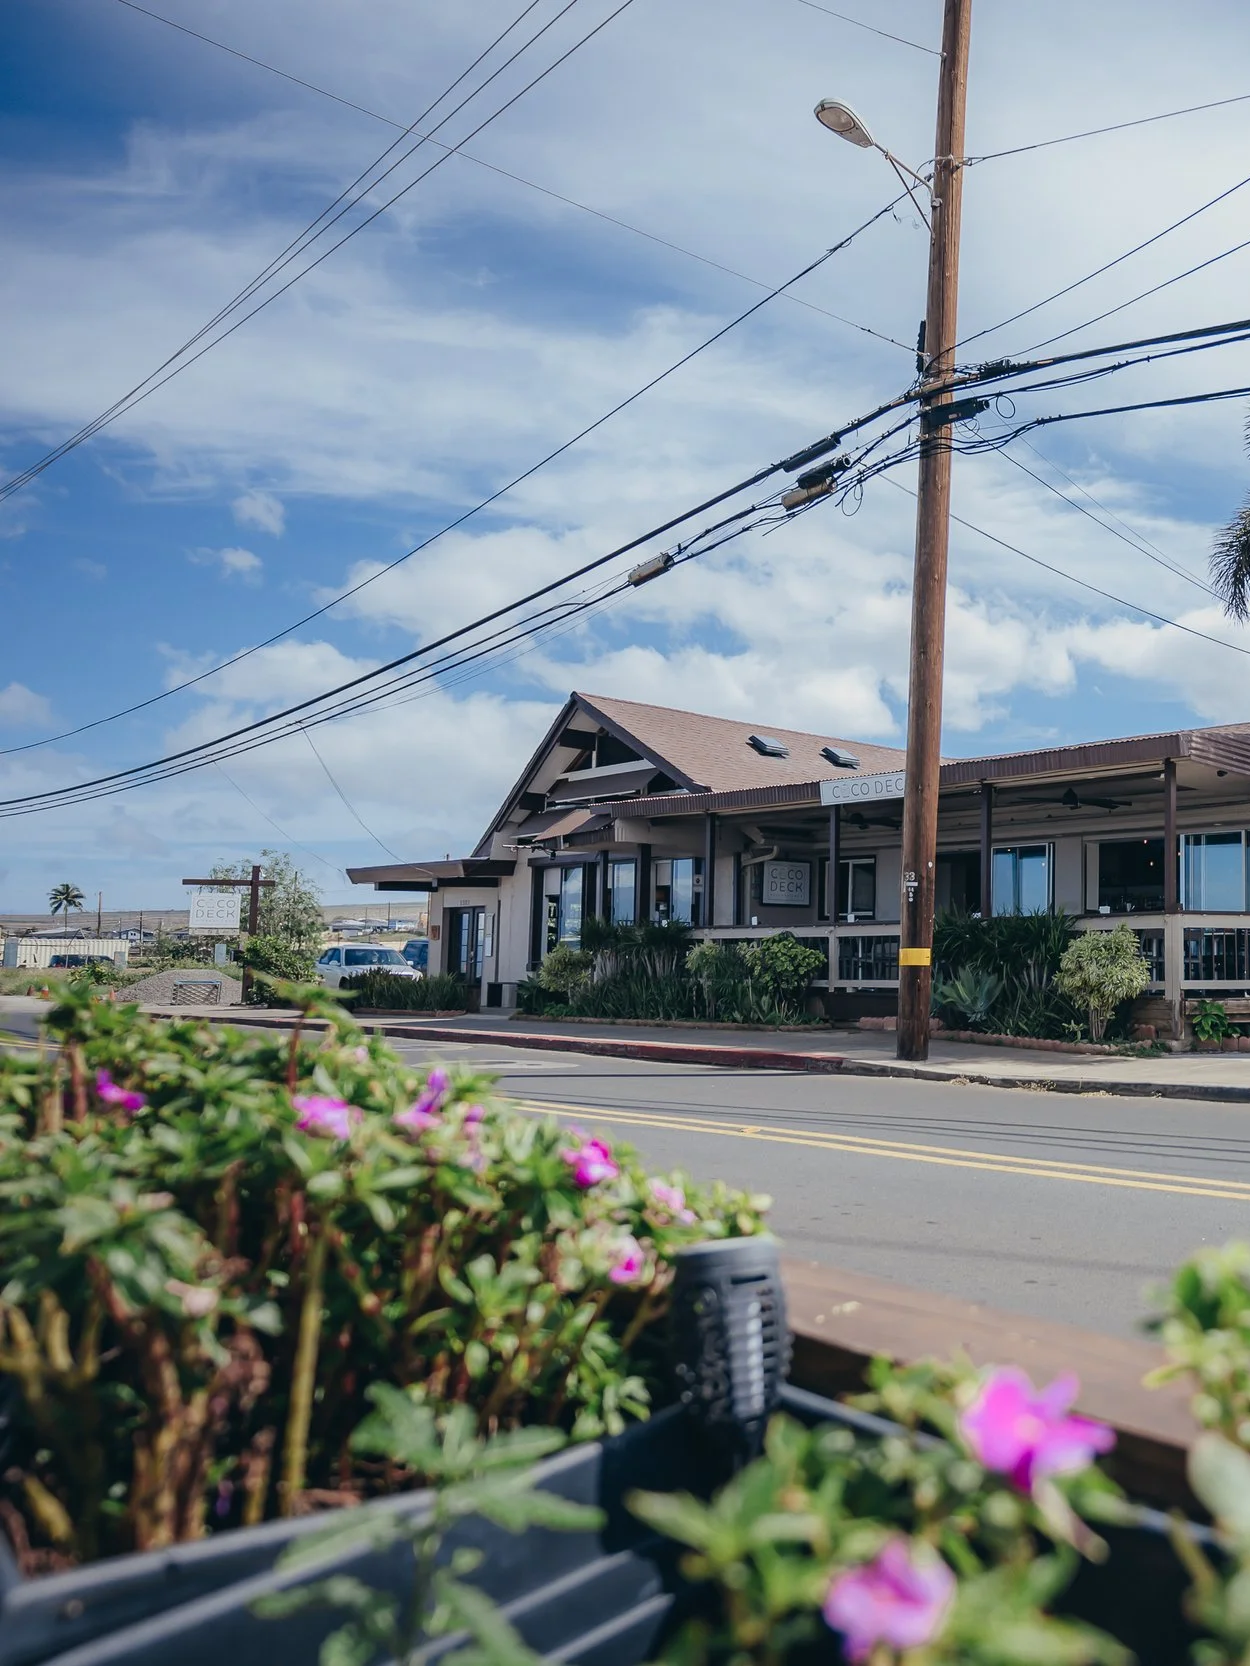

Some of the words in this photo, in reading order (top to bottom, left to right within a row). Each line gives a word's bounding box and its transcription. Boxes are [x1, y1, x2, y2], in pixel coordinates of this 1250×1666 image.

[874, 777, 904, 794] DEC
[770, 880, 803, 893] DECK
[195, 909, 235, 919] DECK
